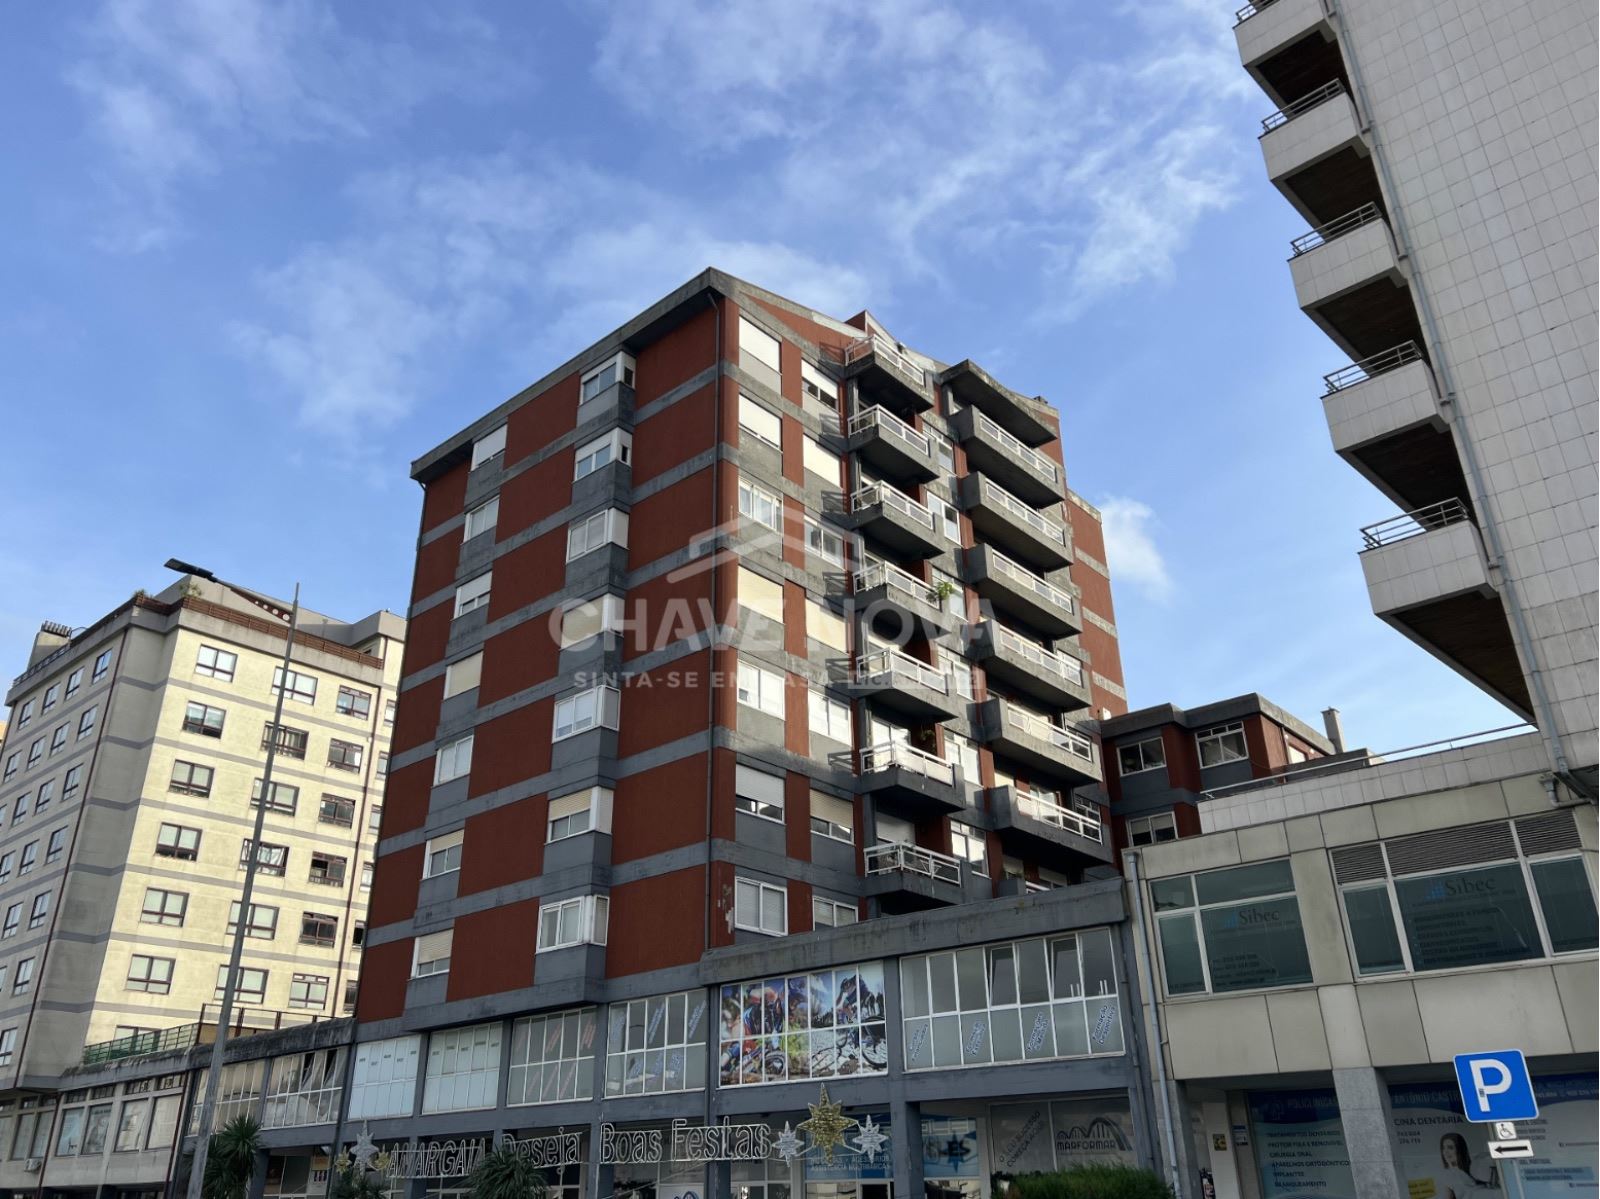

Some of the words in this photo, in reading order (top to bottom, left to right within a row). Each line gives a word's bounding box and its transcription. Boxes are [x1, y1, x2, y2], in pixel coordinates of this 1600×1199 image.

[1445, 877, 1497, 897] Sibec
[1239, 908, 1280, 925] Sibec
[1469, 1059, 1512, 1113] P
[600, 1122, 662, 1163] Boas
[671, 1116, 773, 1161] Festas
[1056, 1139, 1116, 1151] MARFORMAR
